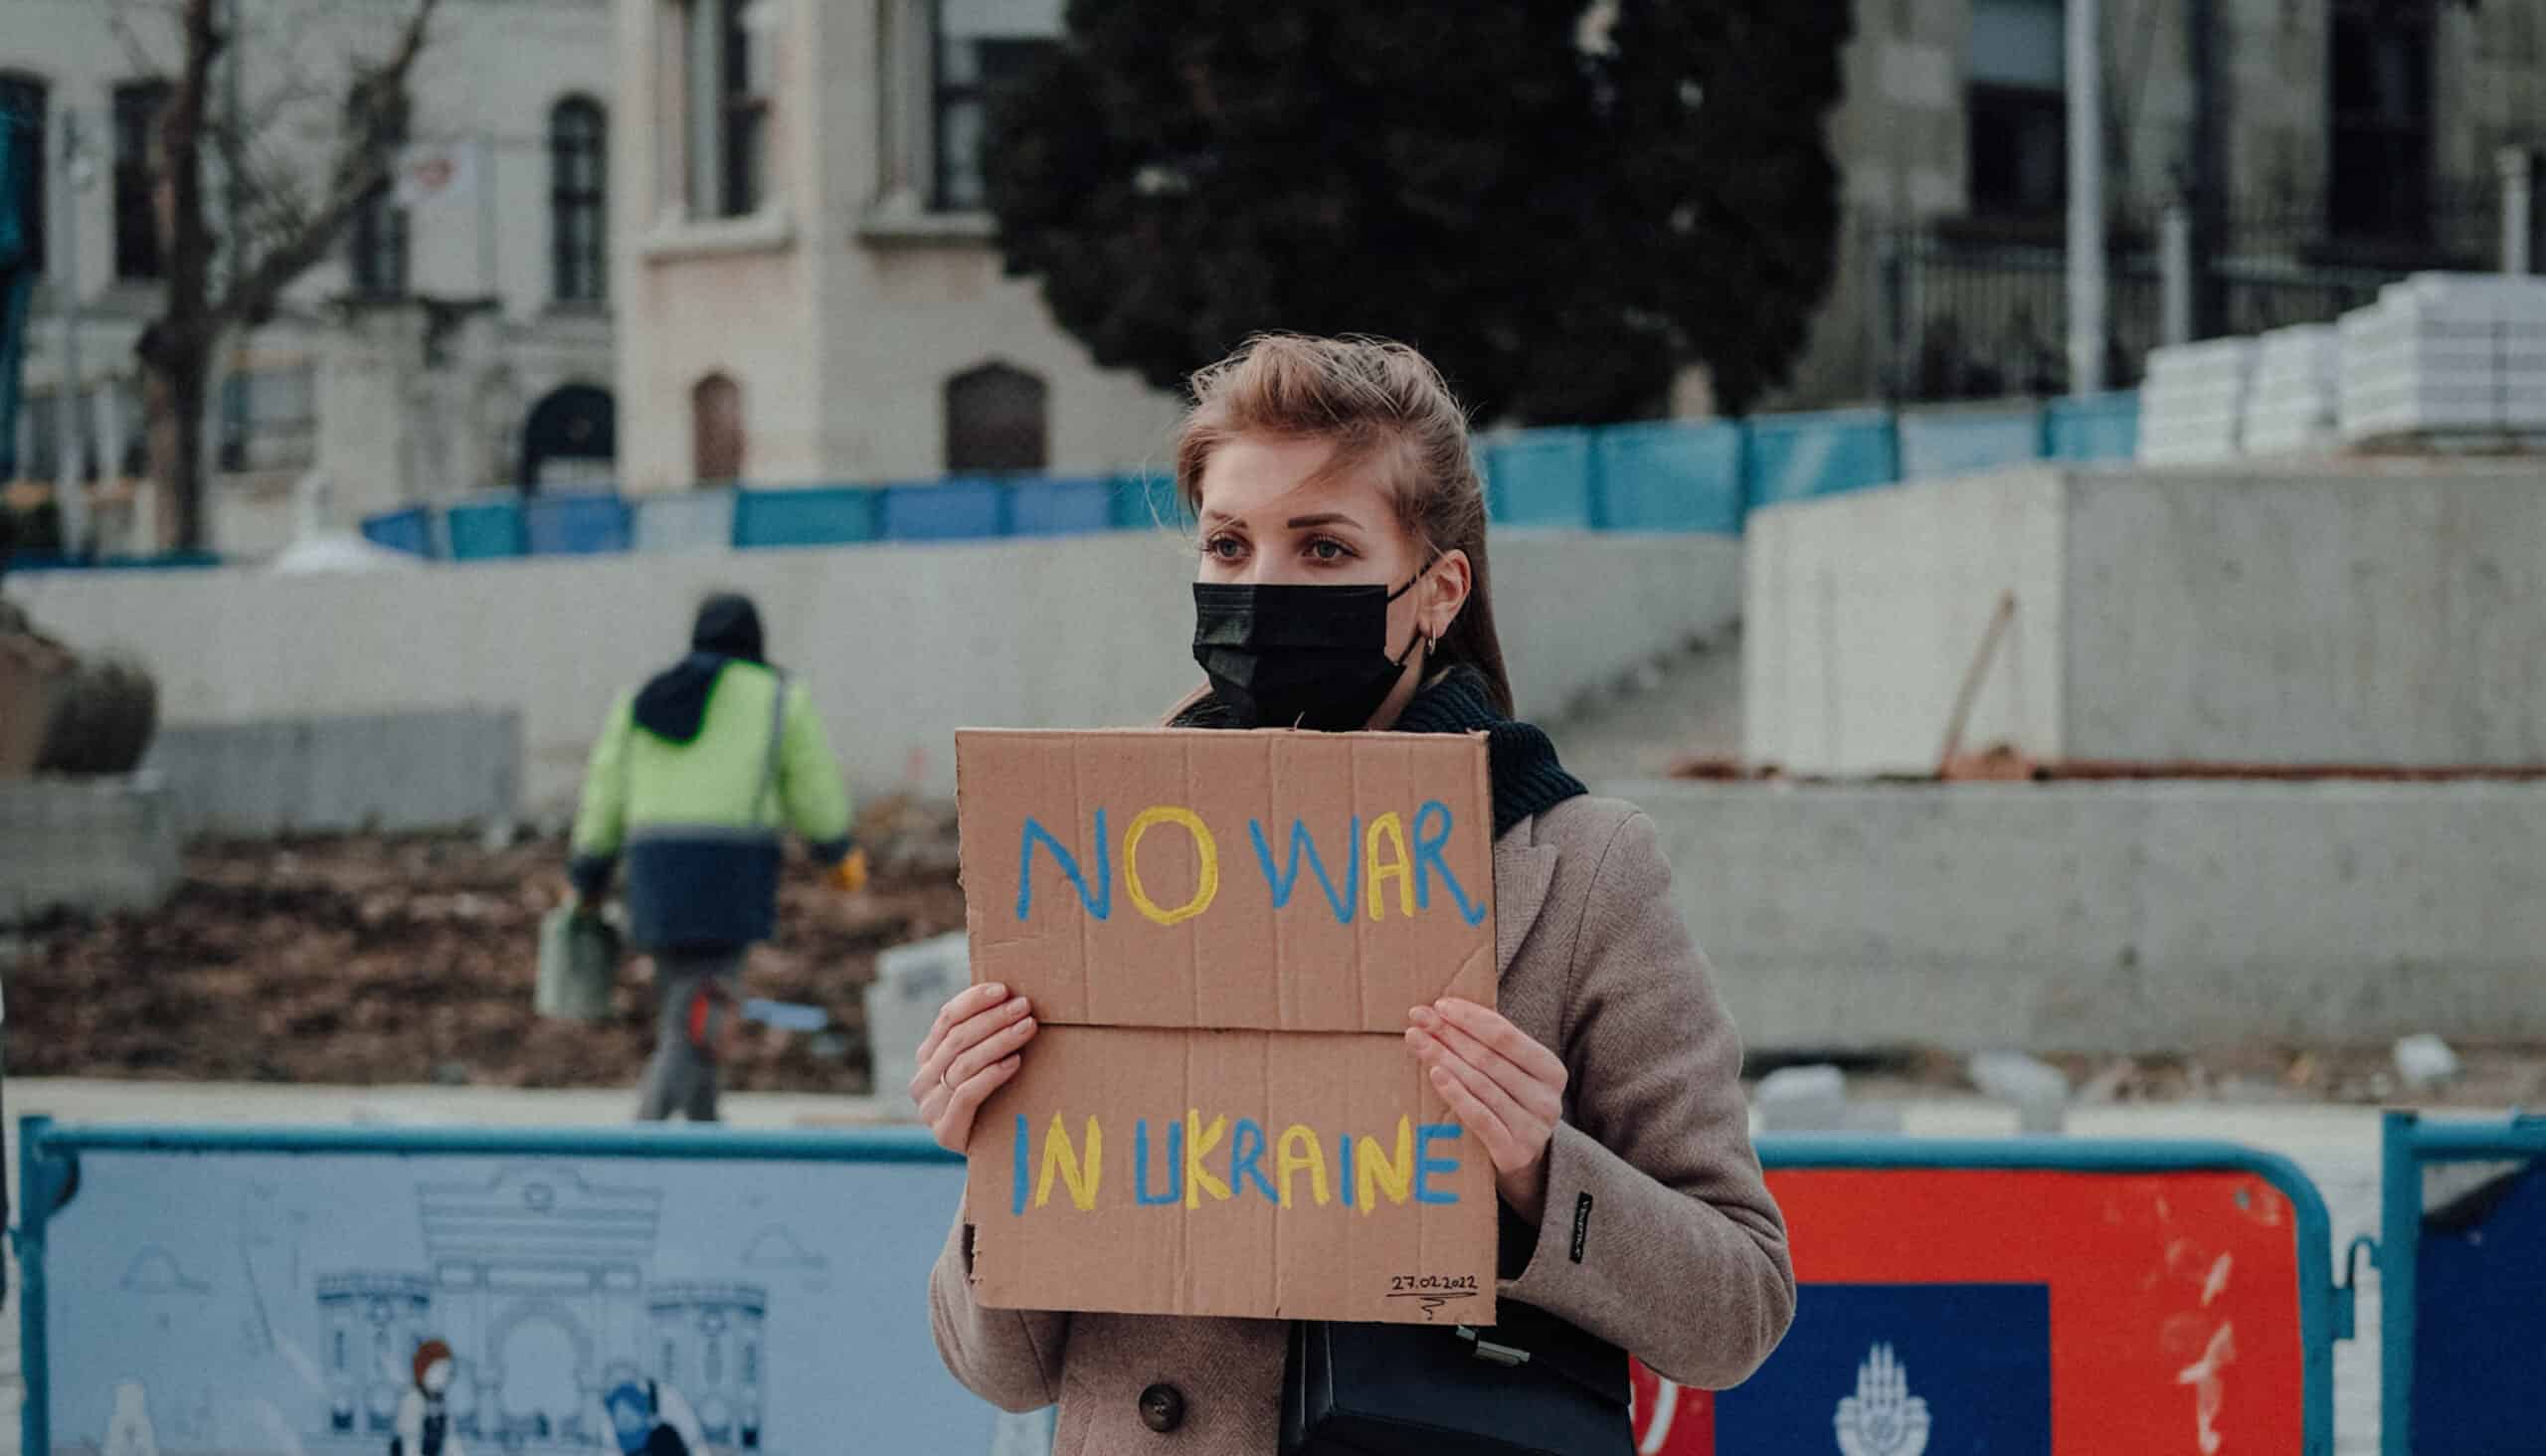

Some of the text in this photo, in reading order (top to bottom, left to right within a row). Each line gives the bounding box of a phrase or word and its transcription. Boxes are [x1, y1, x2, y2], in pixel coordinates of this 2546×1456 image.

[1015, 801, 1486, 926] NO WAR
[1012, 1109, 1463, 1215] IN UKRAINE
